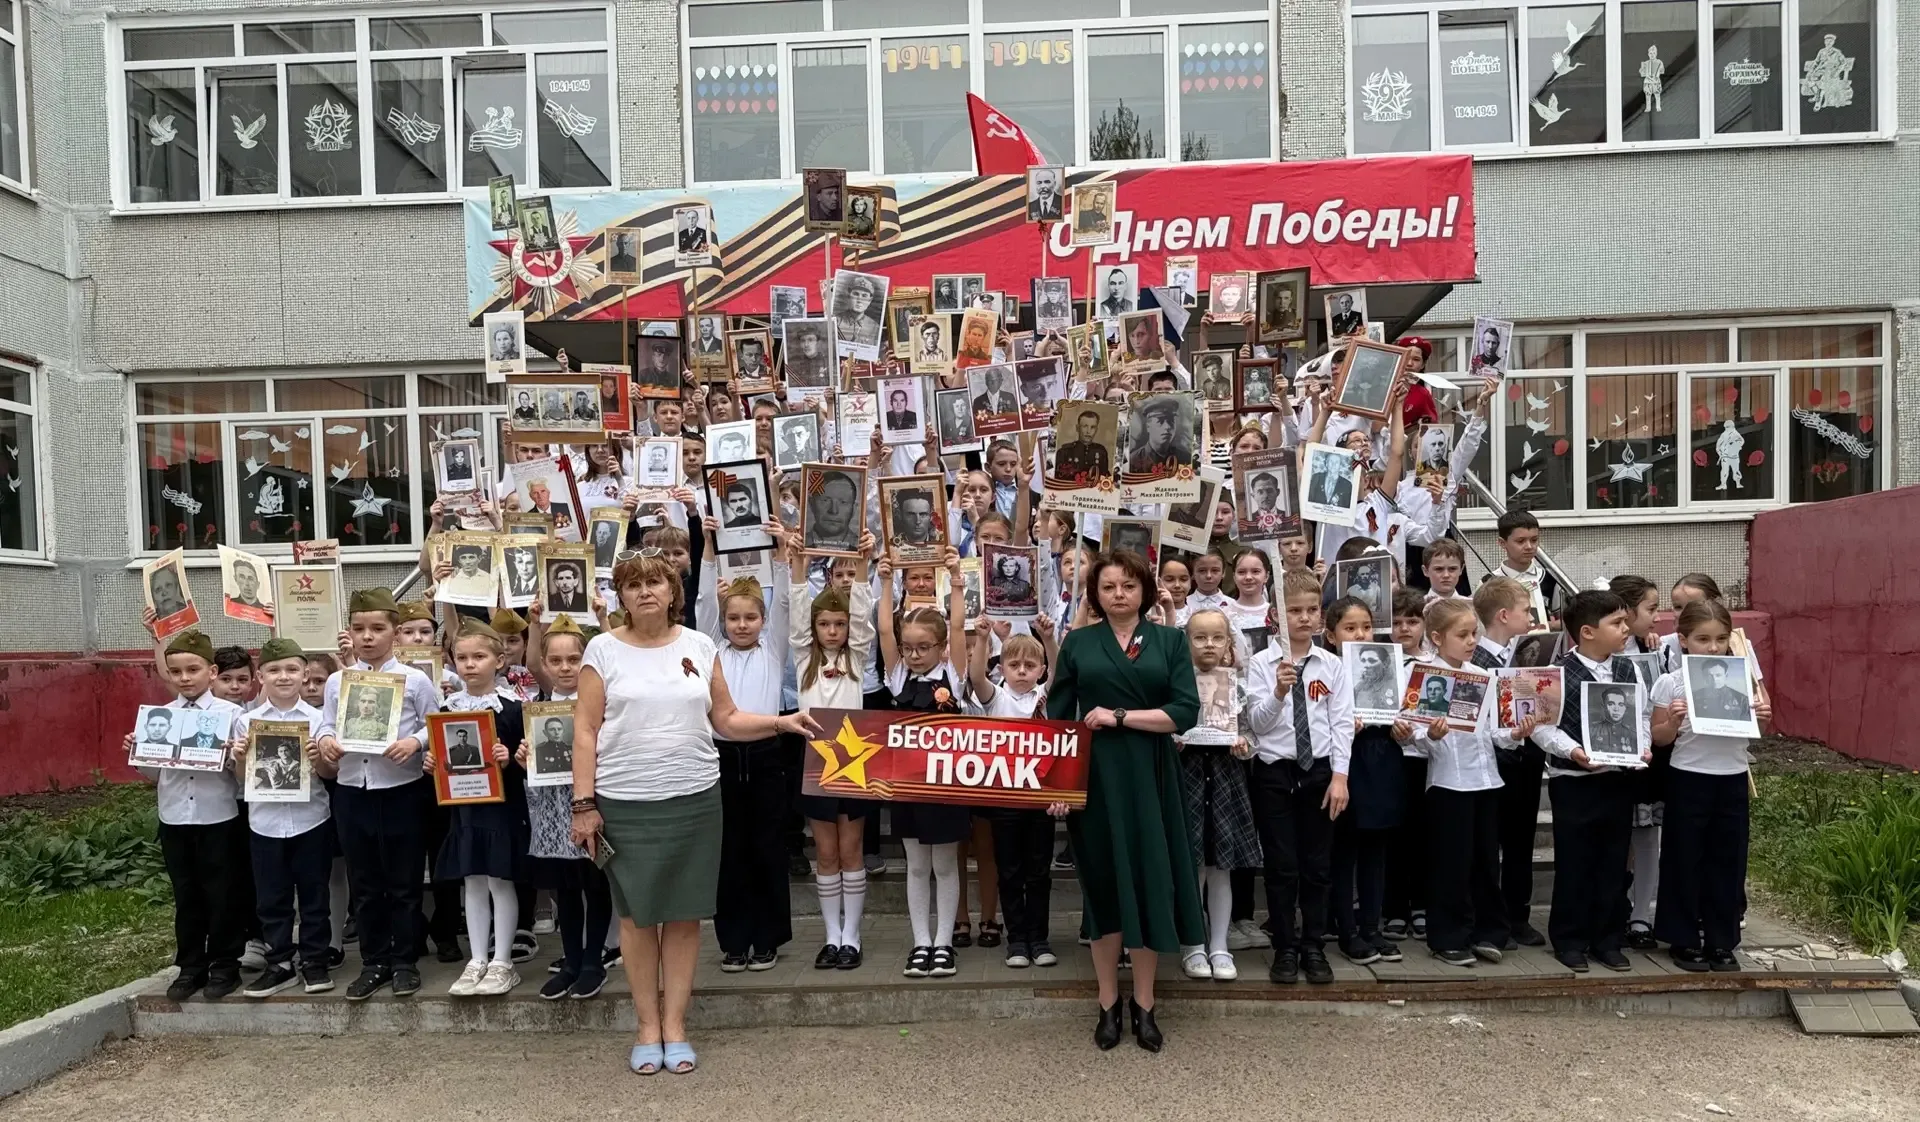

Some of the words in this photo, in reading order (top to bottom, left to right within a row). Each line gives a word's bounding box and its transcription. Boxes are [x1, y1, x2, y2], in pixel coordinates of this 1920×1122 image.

[883, 44, 962, 73] 1941
[988, 39, 1072, 67] 1945
[1451, 64, 1500, 75] ПОБЕДЫ
[550, 79, 591, 93] 1941-1945
[1378, 84, 1394, 103] 9
[1377, 112, 1398, 121] МАЯ
[1454, 105, 1498, 118] 1941-1945
[320, 114, 336, 134] 9
[319, 142, 340, 151] МАЯ
[1093, 210, 1231, 263] Днем
[1245, 195, 1460, 249] Победы!
[1140, 491, 1163, 499] Михаил
[1164, 491, 1195, 499] Петрович
[888, 724, 1079, 758] БЕССМЕРТНЫЙ
[925, 751, 1042, 789] ПОЛК
